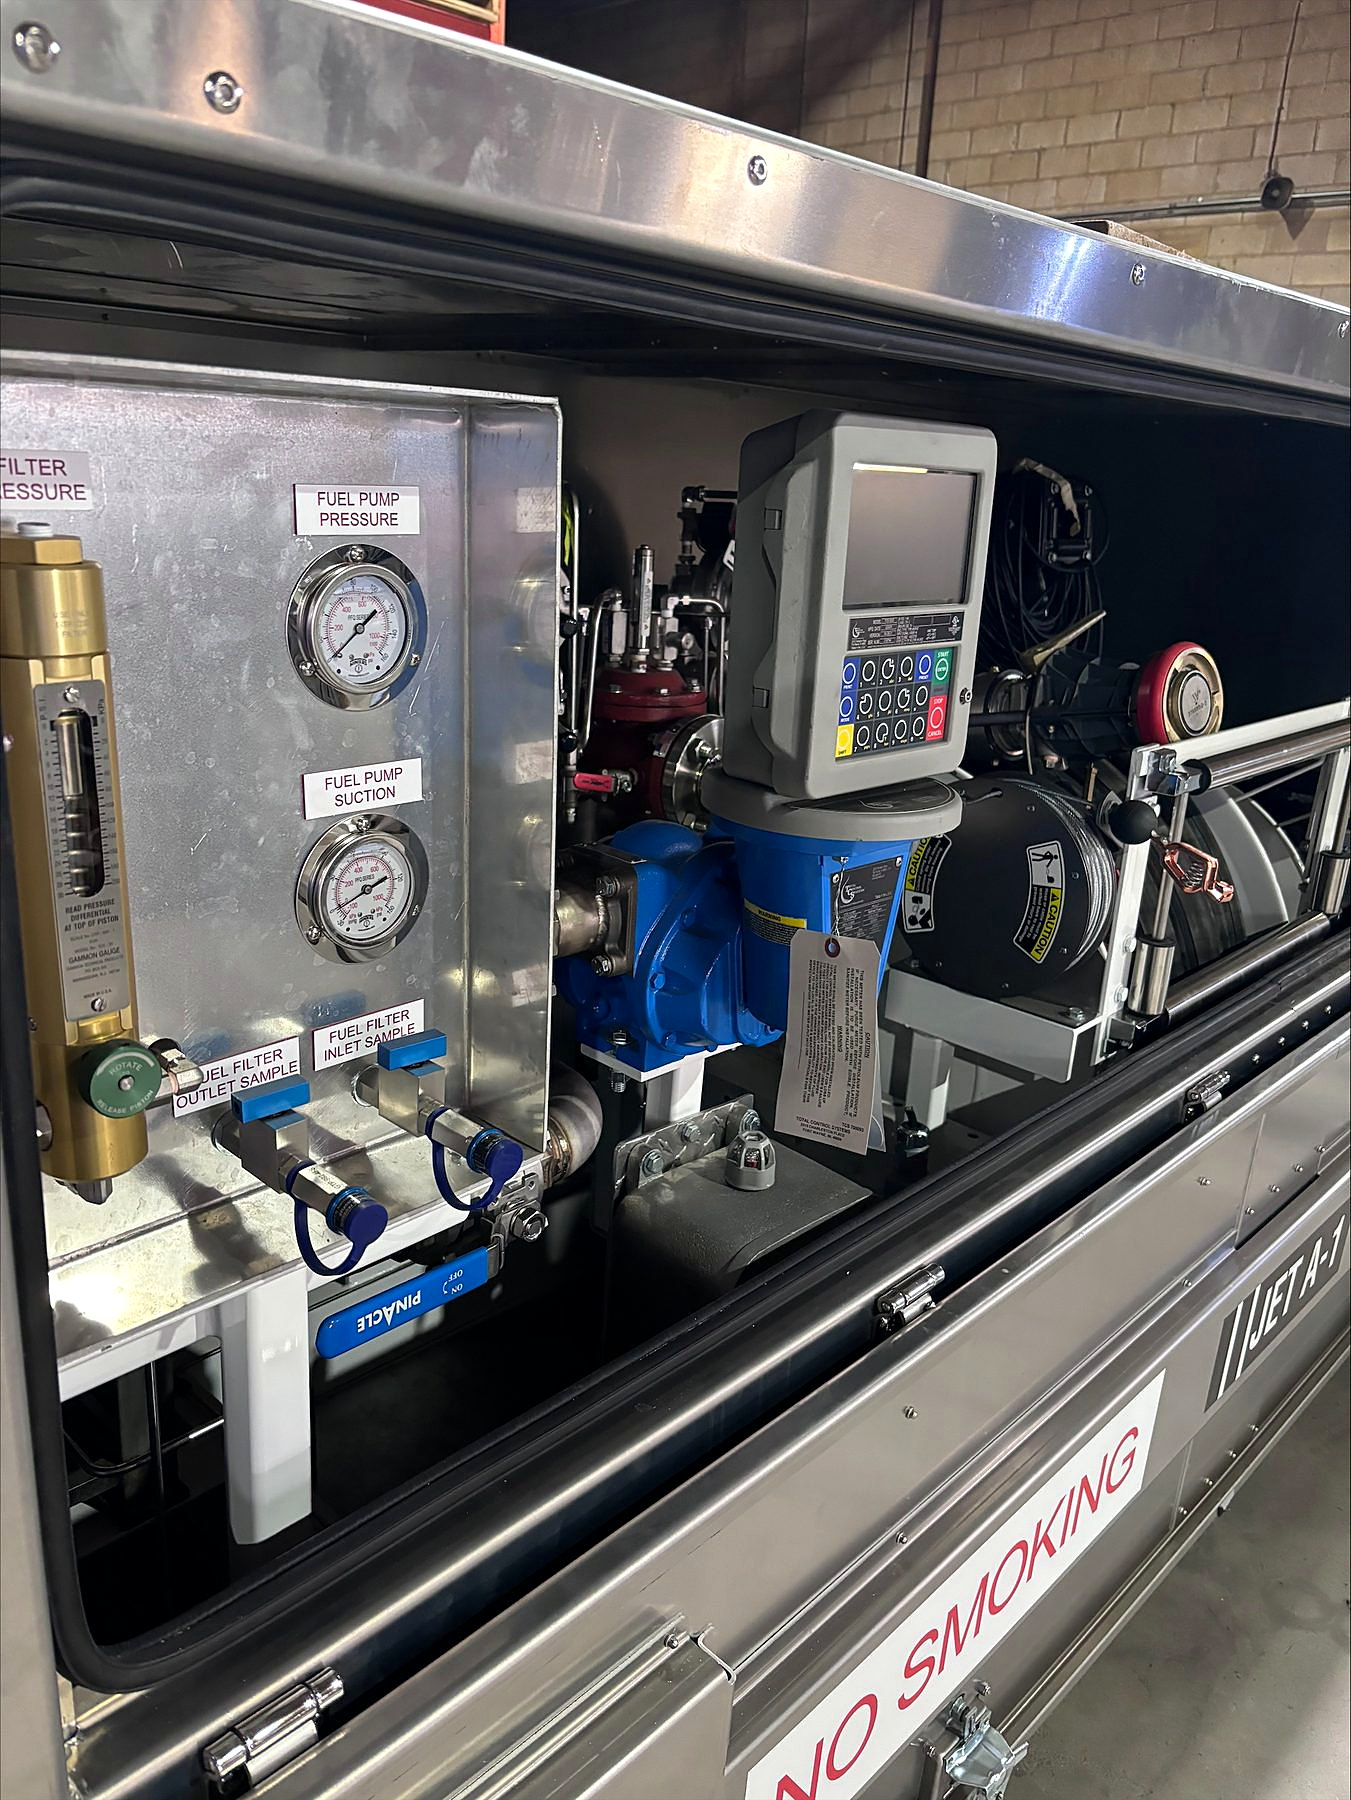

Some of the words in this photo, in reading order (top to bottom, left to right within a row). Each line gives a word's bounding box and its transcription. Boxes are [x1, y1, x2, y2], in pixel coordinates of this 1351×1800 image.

[0, 482, 87, 501] ESSURE
[317, 491, 355, 506] FUEL
[359, 492, 400, 507] PUMP
[320, 512, 399, 527] PRESSURE
[325, 773, 360, 791] FUEL
[364, 767, 403, 785] PUMP
[334, 786, 396, 807] SUCTION
[908, 837, 929, 876] CAUTIO
[65, 904, 82, 914] READ
[83, 898, 115, 911] PRESSURE
[70, 908, 111, 922] DIFFERENTIAL
[74, 922, 86, 930] TOP
[98, 914, 119, 926] PISTON
[1034, 904, 1059, 955] CAUTION
[69, 951, 98, 964] GAMMON
[99, 946, 120, 958] GAUGE
[329, 1022, 364, 1044] FUEL
[366, 1008, 410, 1033] FILTER
[324, 1042, 359, 1062] INLET
[364, 1022, 416, 1048] SAMPLE
[109, 1062, 143, 1076] ROTATE
[200, 1066, 229, 1084] UEL
[232, 1048, 283, 1074] FILTER
[176, 1080, 236, 1110] OUTLET
[240, 1060, 299, 1089] SAMPLE
[97, 1099, 127, 1114] RELEASE
[129, 1089, 154, 1112] PISTON
[796, 1116, 809, 1124] TOTAL
[810, 1120, 830, 1129] CONTROL
[832, 1125, 851, 1134] SYSTEMS
[448, 1269, 463, 1282] OFF
[1249, 1255, 1305, 1350] JET
[1299, 1214, 1346, 1300] A-1
[451, 1283, 463, 1295] ON
[357, 1290, 421, 1333] PINACLE
[774, 1693, 878, 1800] NO
[898, 1426, 1139, 1710] SMOKING
